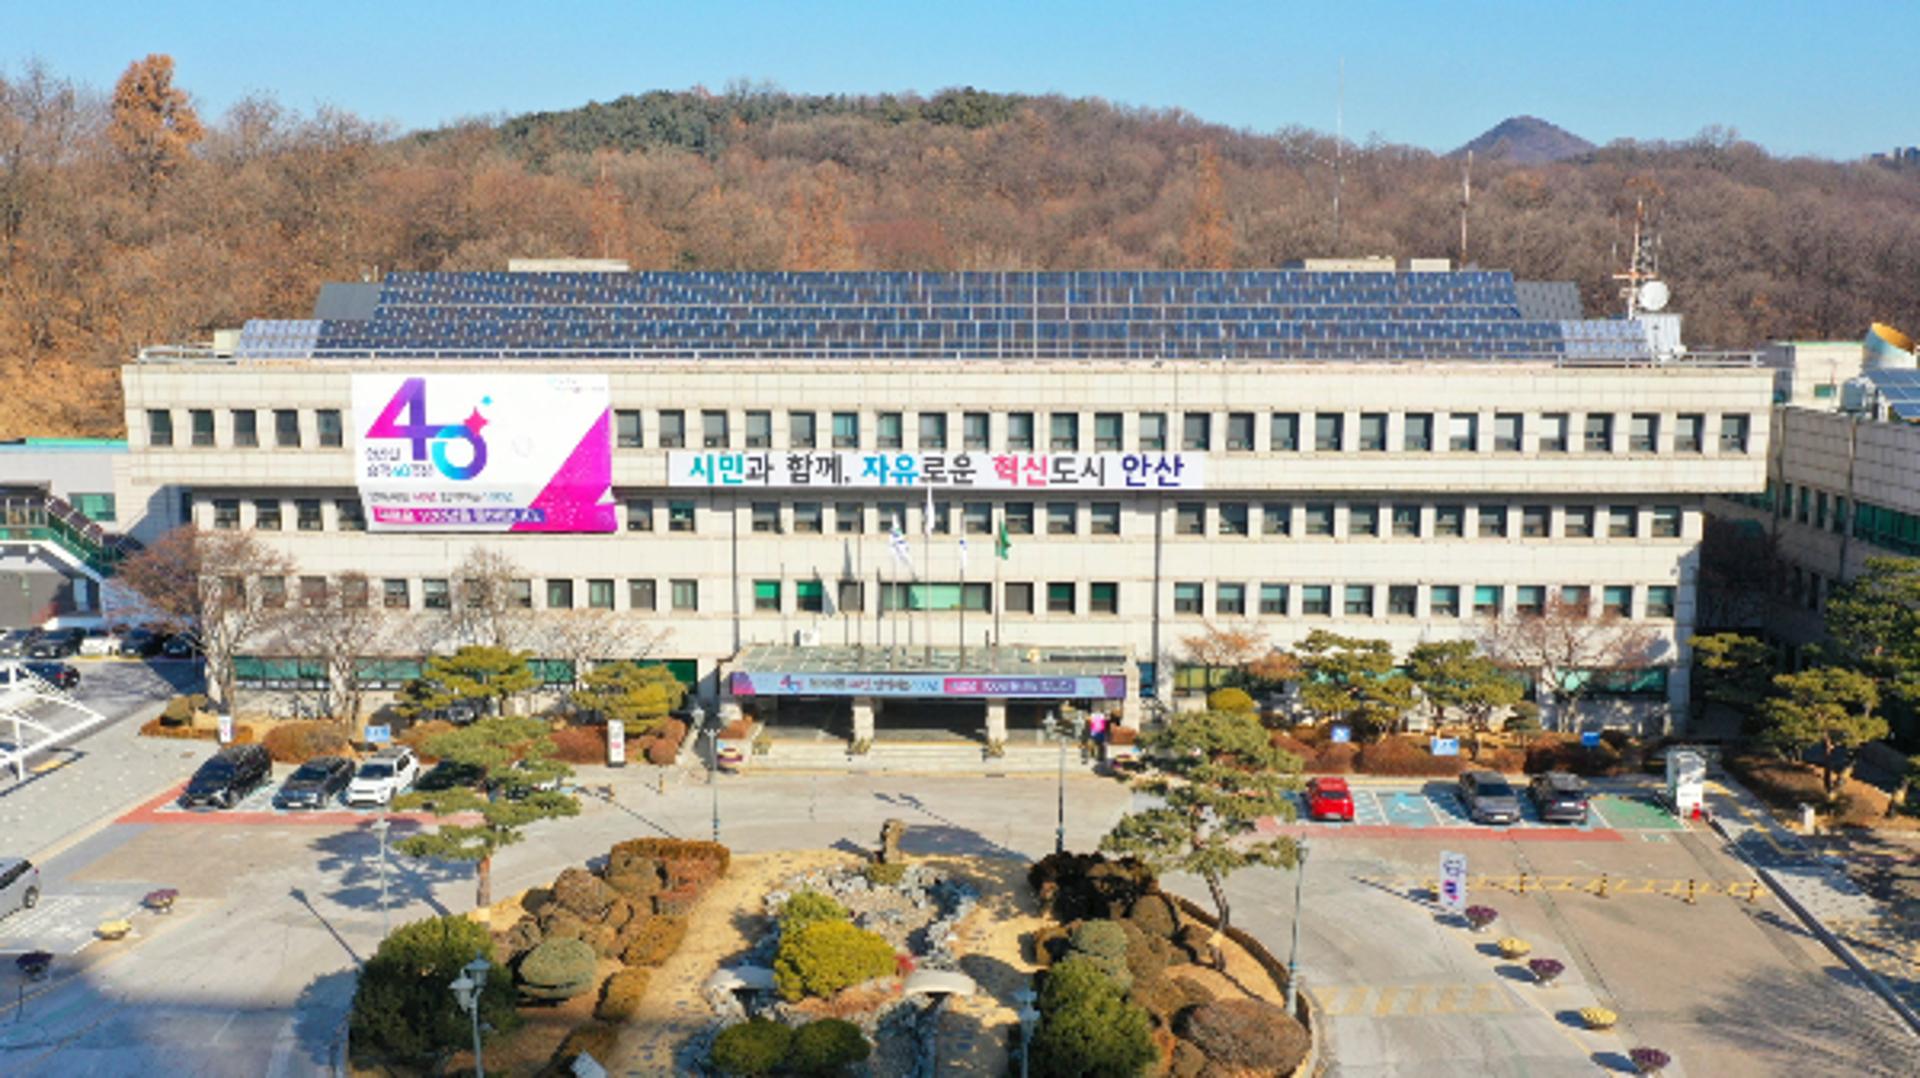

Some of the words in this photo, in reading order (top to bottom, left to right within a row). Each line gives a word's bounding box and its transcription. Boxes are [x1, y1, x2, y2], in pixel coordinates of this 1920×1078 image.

[690, 453, 774, 485] 시민과
[787, 453, 851, 484] 함께,
[862, 453, 976, 486] 자유로운
[992, 455, 1105, 487] 혁신도시
[1122, 454, 1184, 487] 안산
